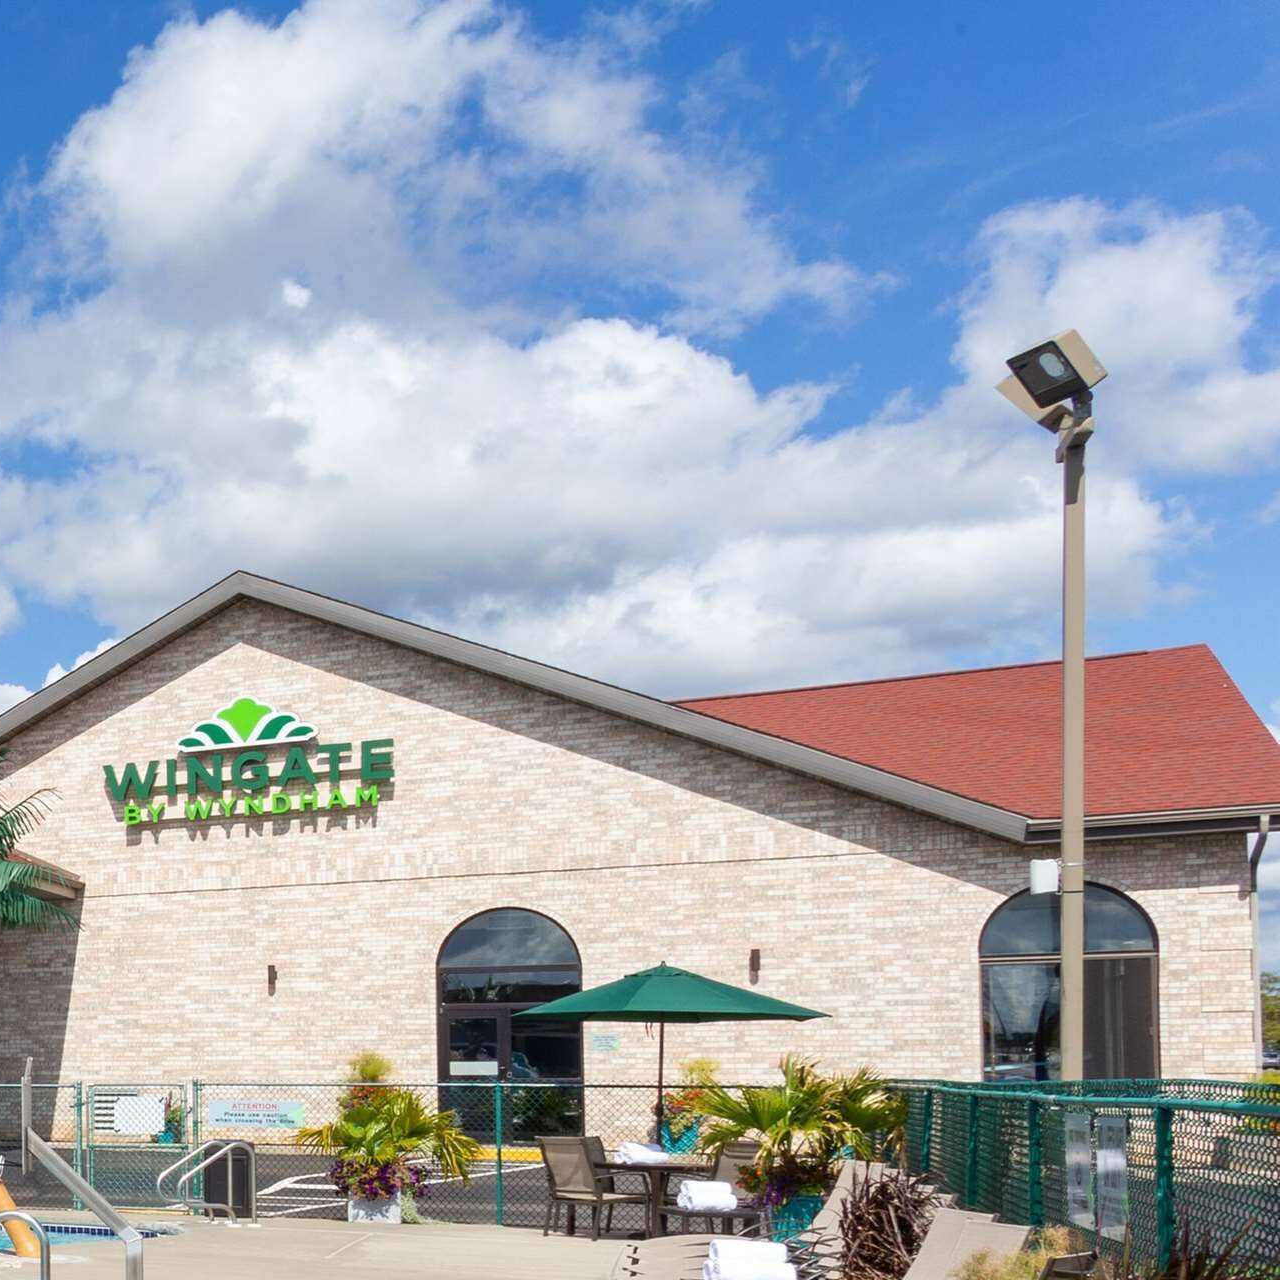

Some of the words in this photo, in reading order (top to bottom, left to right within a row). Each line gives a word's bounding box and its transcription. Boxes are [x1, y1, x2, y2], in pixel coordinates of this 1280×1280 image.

[103, 738, 395, 801] WINGATE
[123, 802, 166, 826] BY
[184, 784, 379, 822] WYNDHAM
